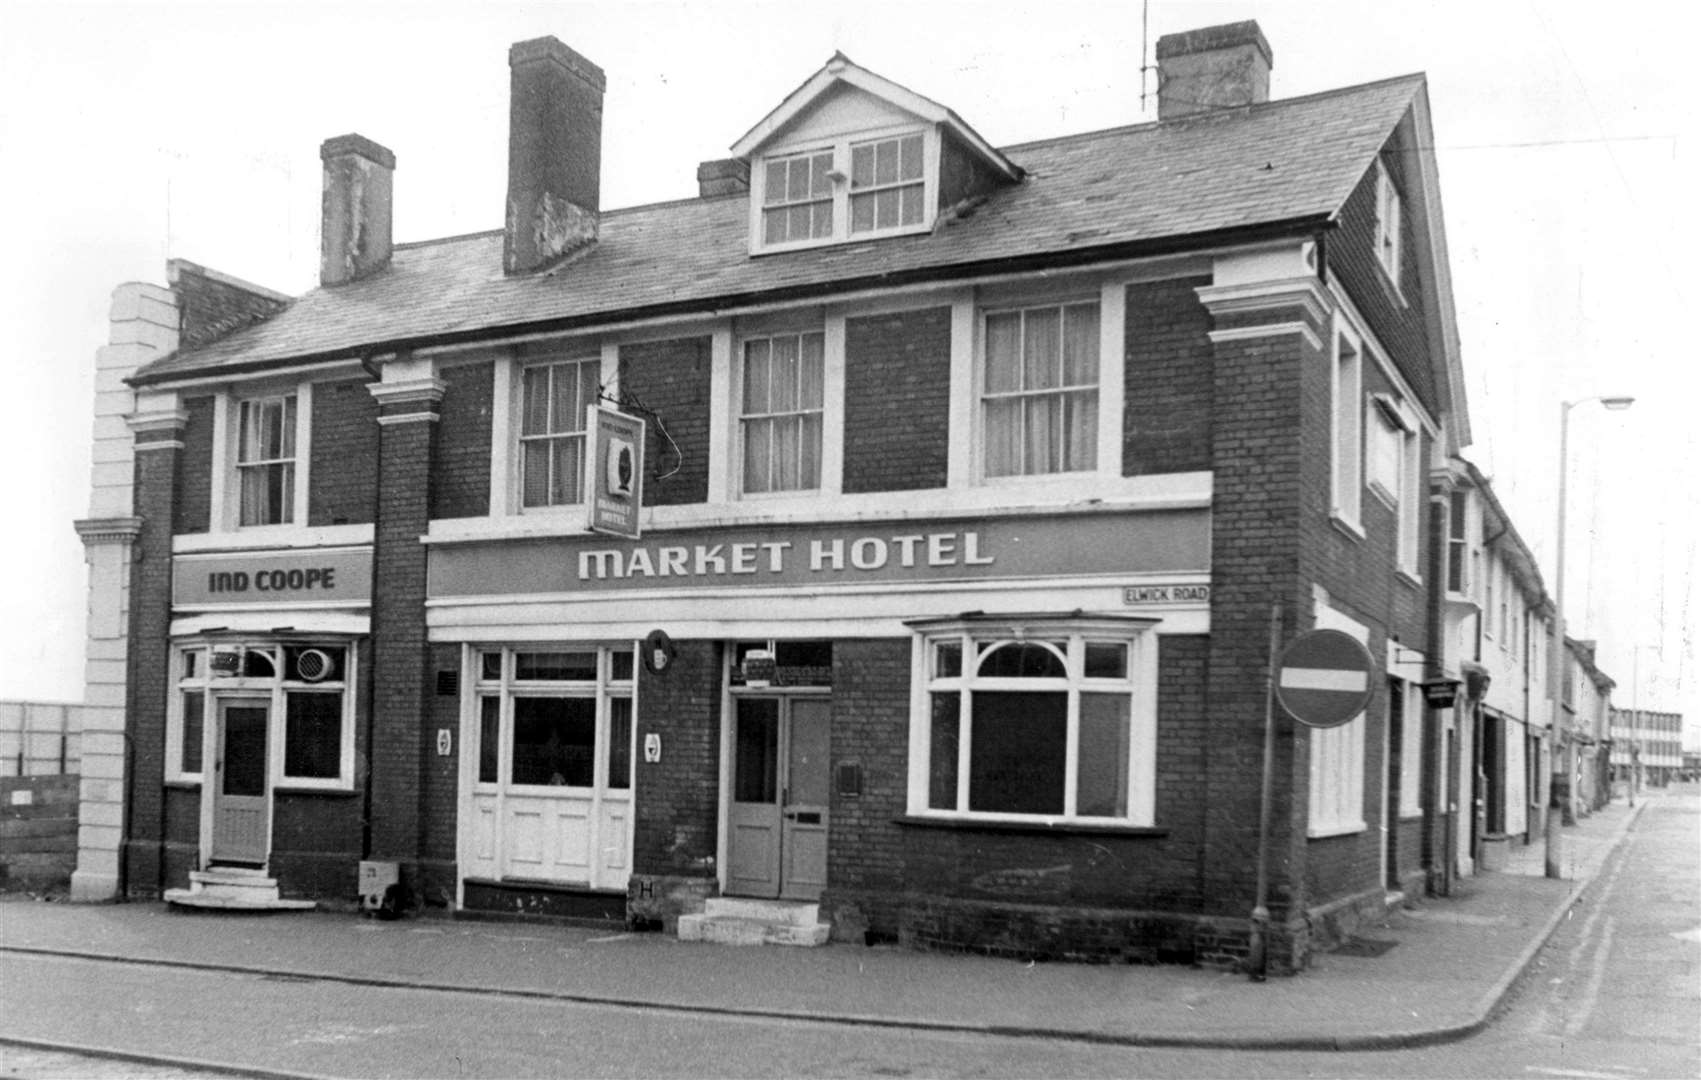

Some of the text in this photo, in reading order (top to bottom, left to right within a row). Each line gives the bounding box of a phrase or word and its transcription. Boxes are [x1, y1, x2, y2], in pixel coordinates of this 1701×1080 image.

[578, 532, 995, 580] MARKET HOTEL
[208, 567, 335, 593] IND COOPE
[1126, 587, 1209, 602] ELWICK ROAD
